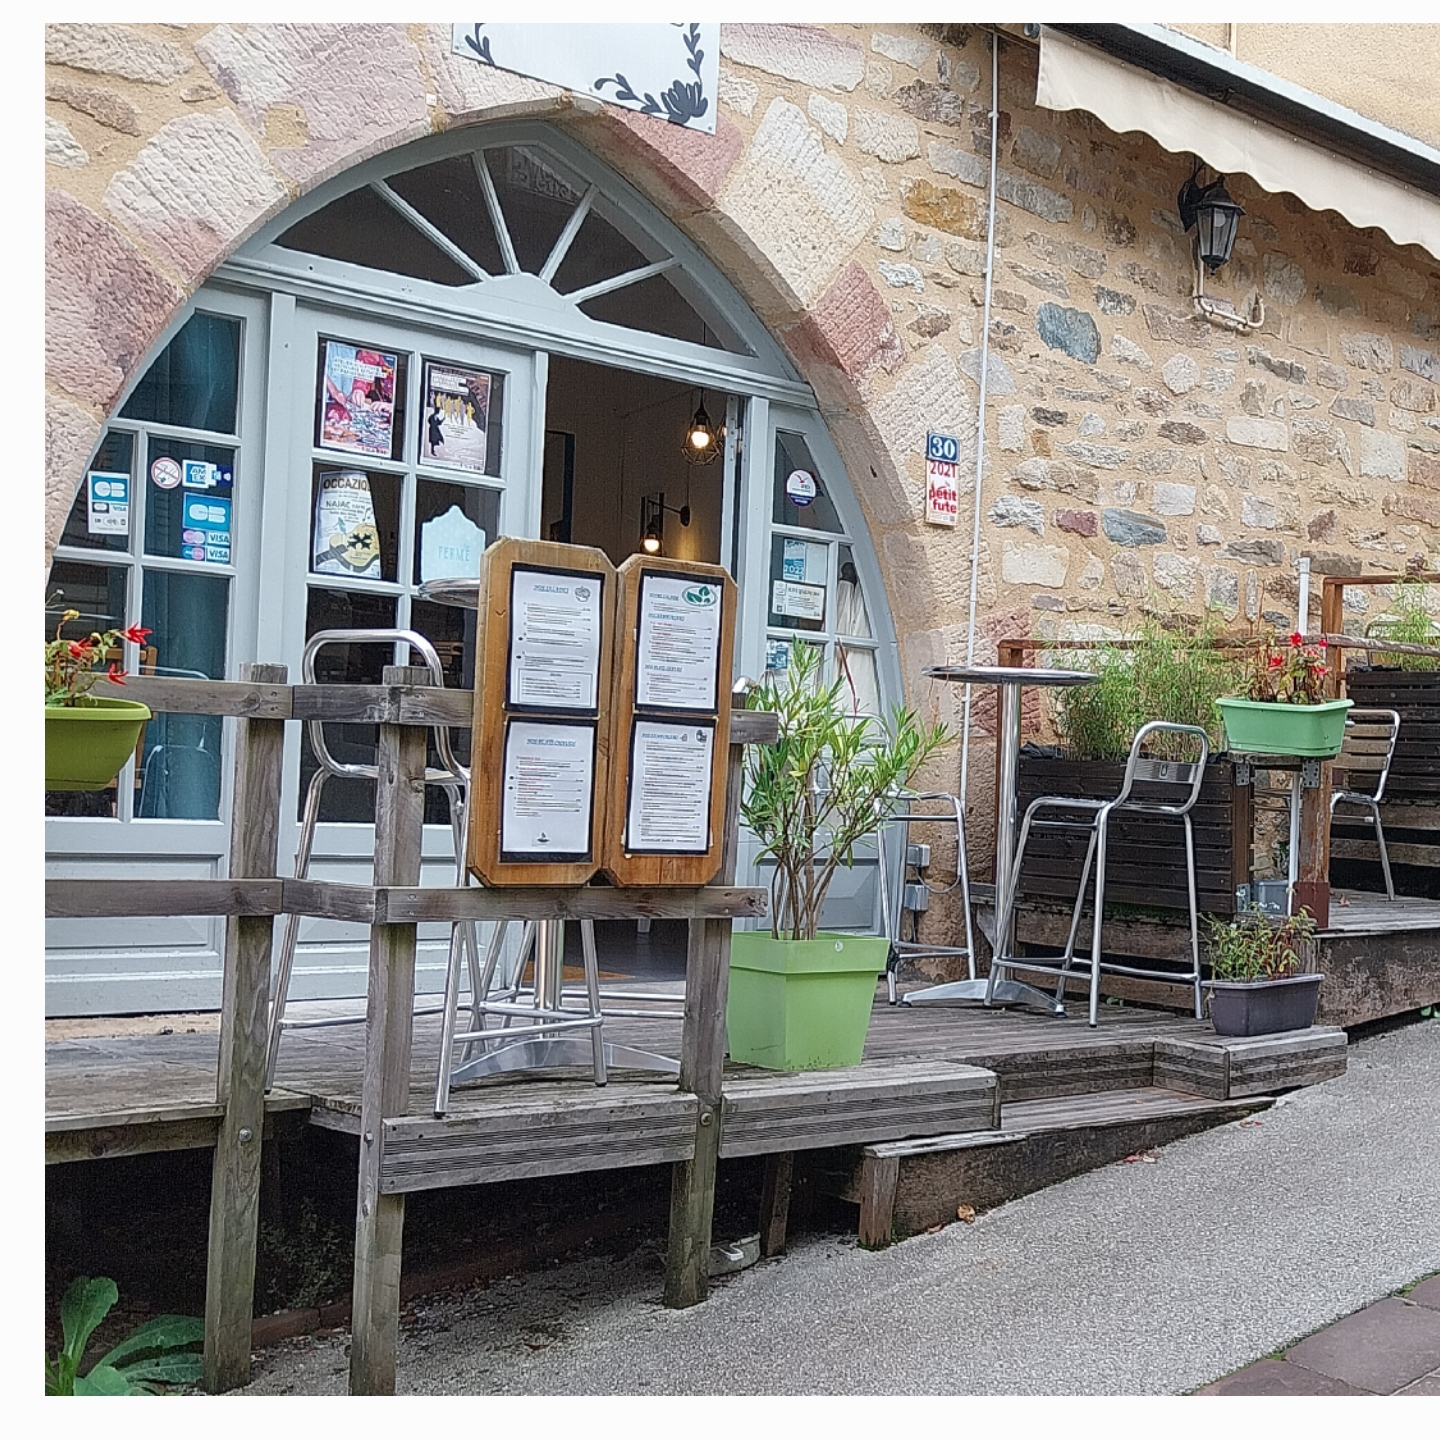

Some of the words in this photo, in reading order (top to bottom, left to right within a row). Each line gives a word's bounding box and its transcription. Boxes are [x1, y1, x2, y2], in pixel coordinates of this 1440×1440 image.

[931, 437, 956, 458] 30
[930, 460, 956, 479] 2021
[928, 486, 957, 502] petit
[209, 533, 229, 543] VISA
[209, 550, 229, 559] VISA
